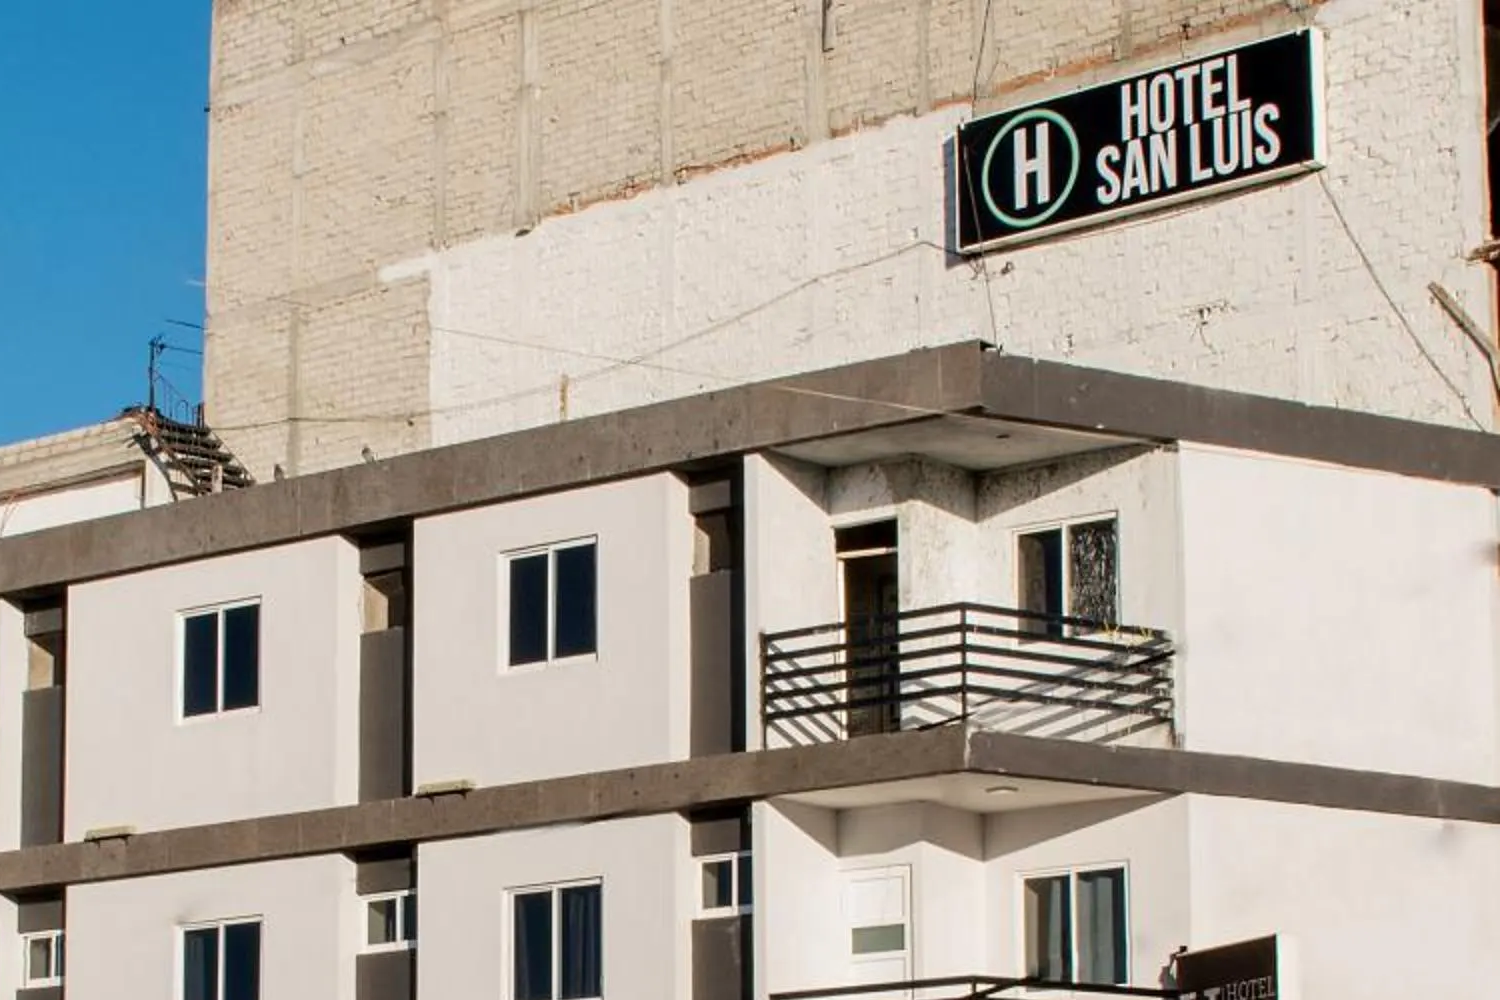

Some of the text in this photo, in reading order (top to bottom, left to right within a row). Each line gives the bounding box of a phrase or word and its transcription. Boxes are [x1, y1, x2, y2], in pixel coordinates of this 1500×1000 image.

[1120, 54, 1253, 142] HOTEL
[1013, 121, 1052, 211] H
[1095, 102, 1282, 205] SAN LUIS
